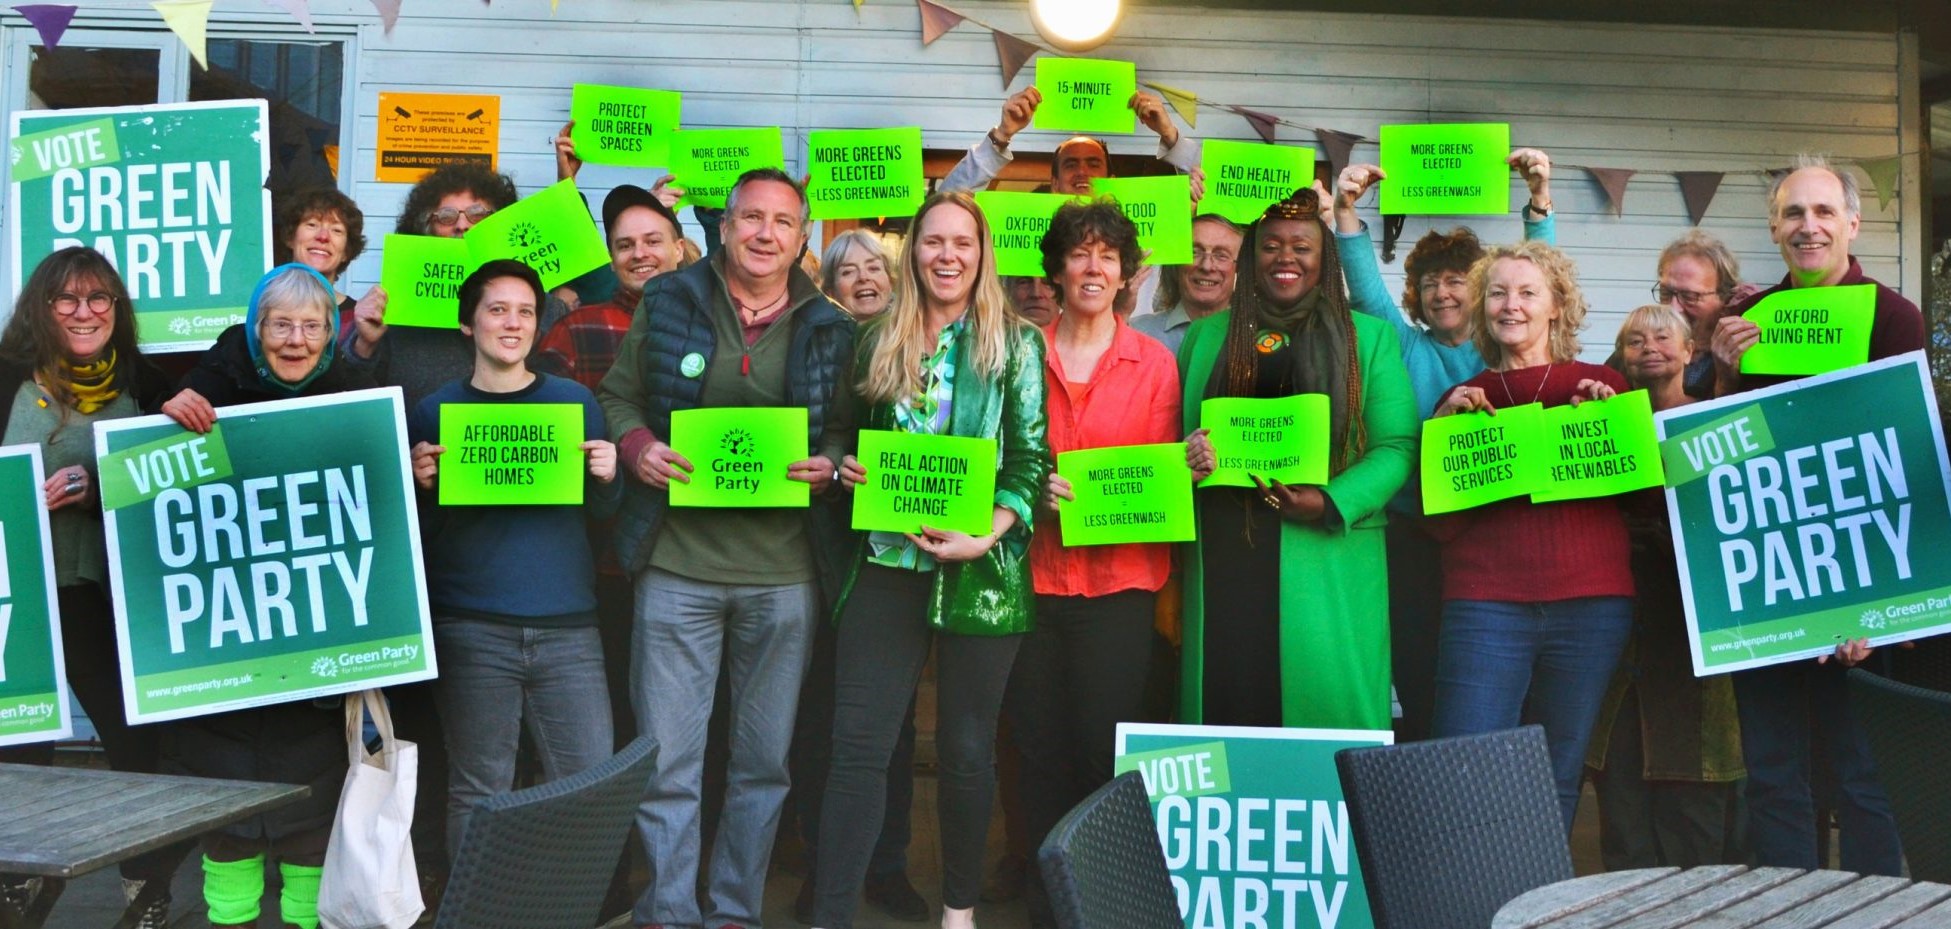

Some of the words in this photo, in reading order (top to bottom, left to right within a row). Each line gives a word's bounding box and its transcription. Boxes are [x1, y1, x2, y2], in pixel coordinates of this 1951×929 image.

[1058, 81, 1111, 96] 15-MINUTE
[599, 102, 647, 119] PROTECT
[1071, 97, 1094, 110] CITY
[394, 125, 417, 133] CCTV
[419, 126, 485, 134] SURVEILLANCE
[592, 118, 614, 133] OUR
[616, 121, 652, 136] GREEN
[32, 127, 106, 172] VOTE
[600, 136, 642, 152] SPACES
[691, 148, 714, 158] MORE
[717, 146, 750, 158] GREENS
[1411, 144, 1435, 155] MORE
[1439, 143, 1473, 155] GREENS
[816, 147, 849, 163] MORE
[853, 145, 902, 162] GREENS
[704, 160, 740, 172] ELECTED
[1423, 158, 1461, 169] ELECTED
[831, 165, 886, 182] ELECTED
[1221, 165, 1244, 180] END
[1247, 167, 1291, 184] HEALTH
[52, 160, 232, 233] GREEN
[688, 187, 708, 196] LESS
[845, 186, 910, 200] GREENWASH
[1216, 182, 1292, 200] INEQUALITIES
[1402, 186, 1424, 197] LESS
[1426, 186, 1481, 197] GREENWASH
[1125, 203, 1156, 218] FOOD
[993, 234, 1030, 249] LIVING
[513, 242, 558, 265] reen
[424, 262, 465, 281] SAFER
[538, 258, 561, 275] rty
[415, 281, 462, 299] CYCLIN
[192, 315, 228, 328] Green
[1774, 309, 1829, 324] OXFORD
[1759, 328, 1803, 344] LIVING
[1807, 328, 1843, 344] RENT
[1230, 416, 1255, 428] MORE
[1260, 415, 1294, 429] GREENS
[1562, 419, 1609, 440] INVEST
[464, 425, 555, 442] AFFORDABLE
[1242, 431, 1283, 442] ELECTED
[1449, 426, 1505, 451] PROTECT
[1559, 445, 1574, 460] IN
[1577, 438, 1619, 459] LOCAL
[1680, 416, 1759, 472] VOTE
[461, 446, 497, 464] ZERO
[501, 446, 559, 464] CARBON
[880, 451, 914, 471] REAL
[919, 455, 968, 475] ACTION
[1220, 457, 1242, 468] LESS
[1245, 456, 1300, 471] GREENWASH
[1443, 454, 1469, 473] OUR
[1473, 443, 1517, 468] PUBLIC
[126, 437, 216, 495] VOTE
[712, 458, 763, 473] Green
[1088, 469, 1114, 481] MORE
[1118, 466, 1154, 479] GREENS
[484, 468, 534, 485] HOMES
[715, 476, 760, 494] Party
[882, 473, 900, 491] ON
[904, 475, 964, 496] CLIMATE
[1452, 464, 1513, 492] SERVICES
[1708, 426, 1909, 535] GREEN
[1103, 482, 1143, 495] ELECTED
[893, 495, 949, 516] CHANGE
[153, 464, 373, 568] GREEN
[1084, 514, 1107, 527] LESS
[1109, 512, 1166, 525] GREENWASH
[1719, 503, 1912, 612] PARTY
[163, 547, 374, 654] PARTY
[1886, 602, 1925, 618] Green
[1711, 628, 1806, 652] www.greenparty.org.uk
[338, 650, 380, 666] Green
[382, 644, 418, 660] Party
[353, 665, 364, 673] the
[365, 662, 392, 671] common
[393, 658, 410, 668] good
[146, 673, 253, 698] www.greenparty.org.uk
[19, 701, 54, 718] Party
[1138, 752, 1215, 796] VOTE
[1157, 795, 1348, 875] GREEN
